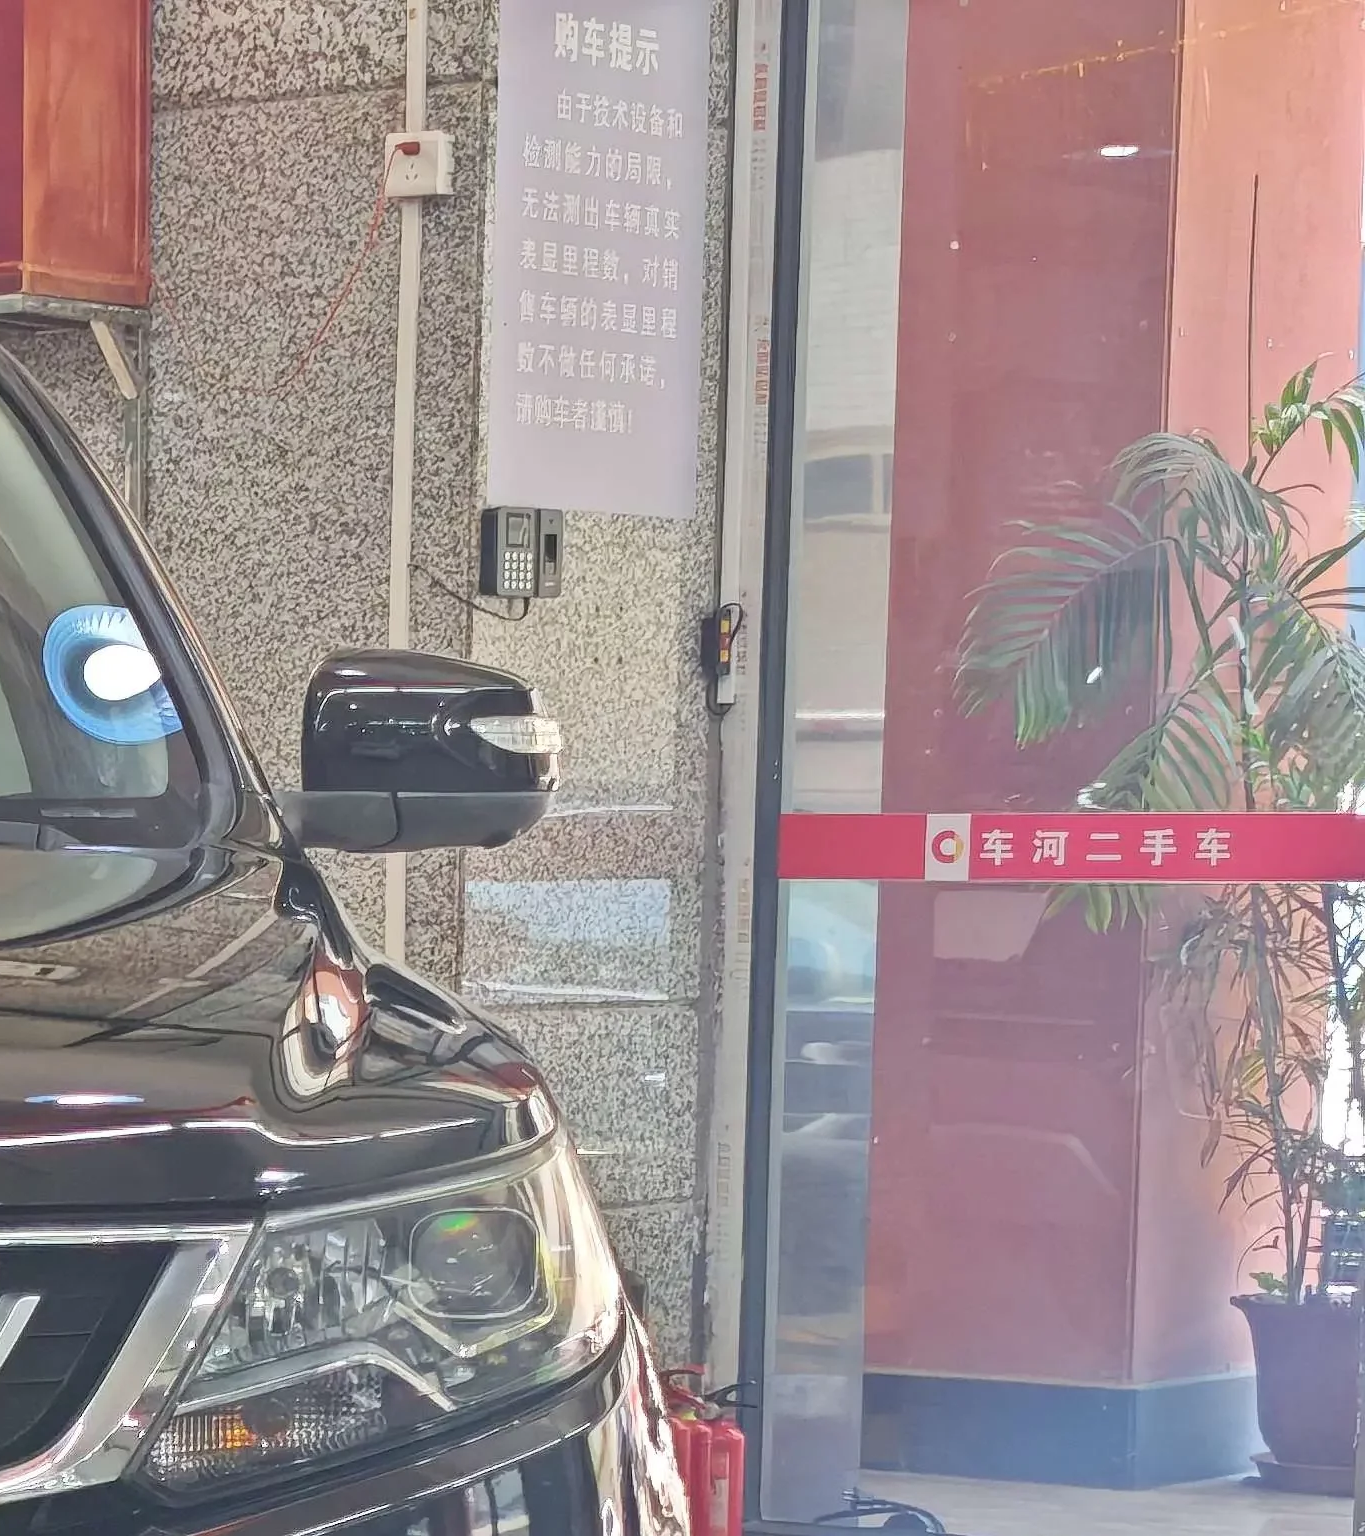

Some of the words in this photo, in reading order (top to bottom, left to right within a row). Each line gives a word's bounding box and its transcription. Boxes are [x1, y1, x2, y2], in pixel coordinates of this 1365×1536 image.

[554, 12, 660, 76] 购车提示
[556, 87, 684, 139] 由于技术设备和
[521, 186, 681, 240] 无法测出车辆真实
[519, 289, 677, 340] 售车辆的表显里程
[979, 827, 1232, 867] 车河二手车
